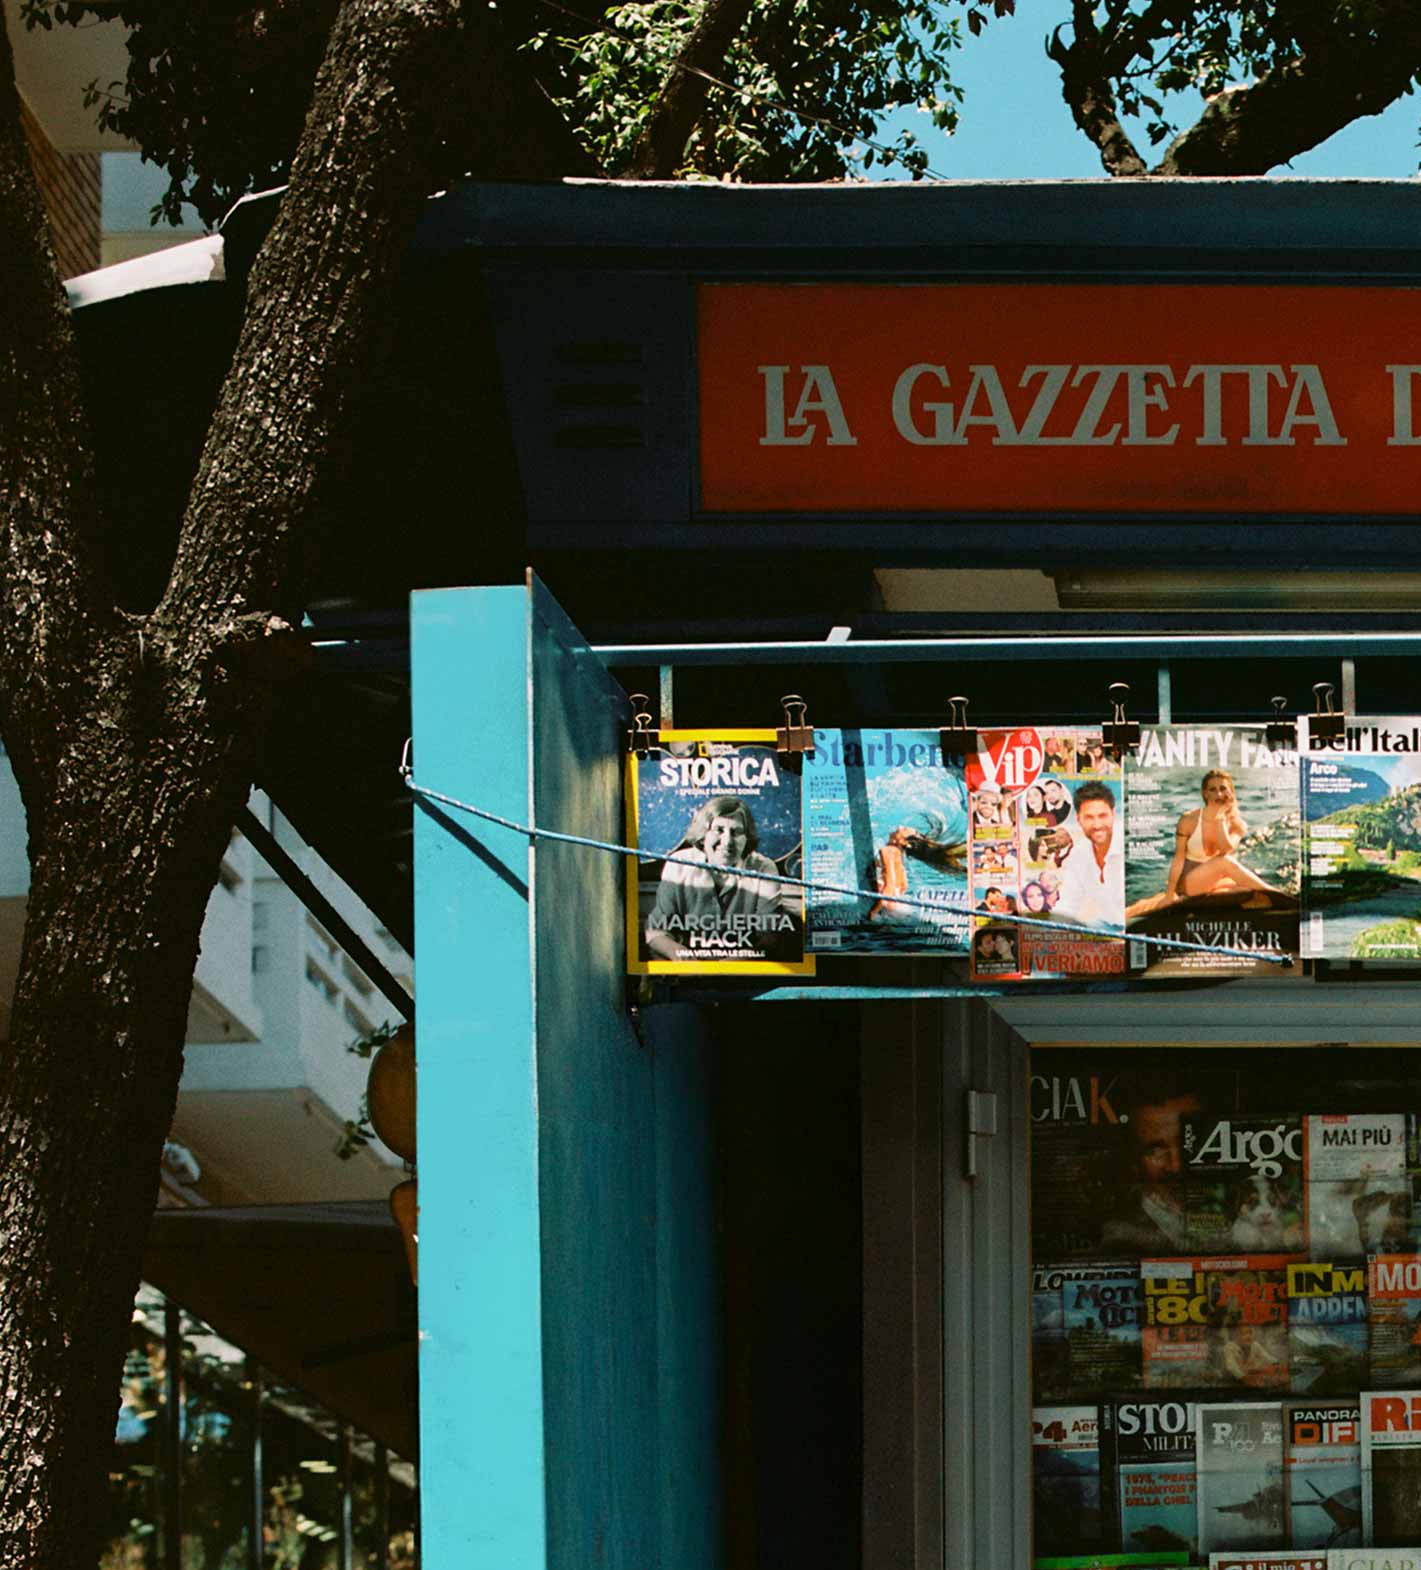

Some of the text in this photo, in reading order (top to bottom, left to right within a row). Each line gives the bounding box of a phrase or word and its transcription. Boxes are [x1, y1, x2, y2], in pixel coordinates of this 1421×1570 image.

[758, 365, 857, 446] LA
[891, 363, 1348, 448] GAZZETTA
[1135, 730, 1234, 768] VANITY
[659, 757, 781, 788] STORICA
[649, 912, 796, 932] MARGHERITA
[688, 930, 753, 949] HACK
[1323, 1124, 1392, 1146] MAI PIÙ
